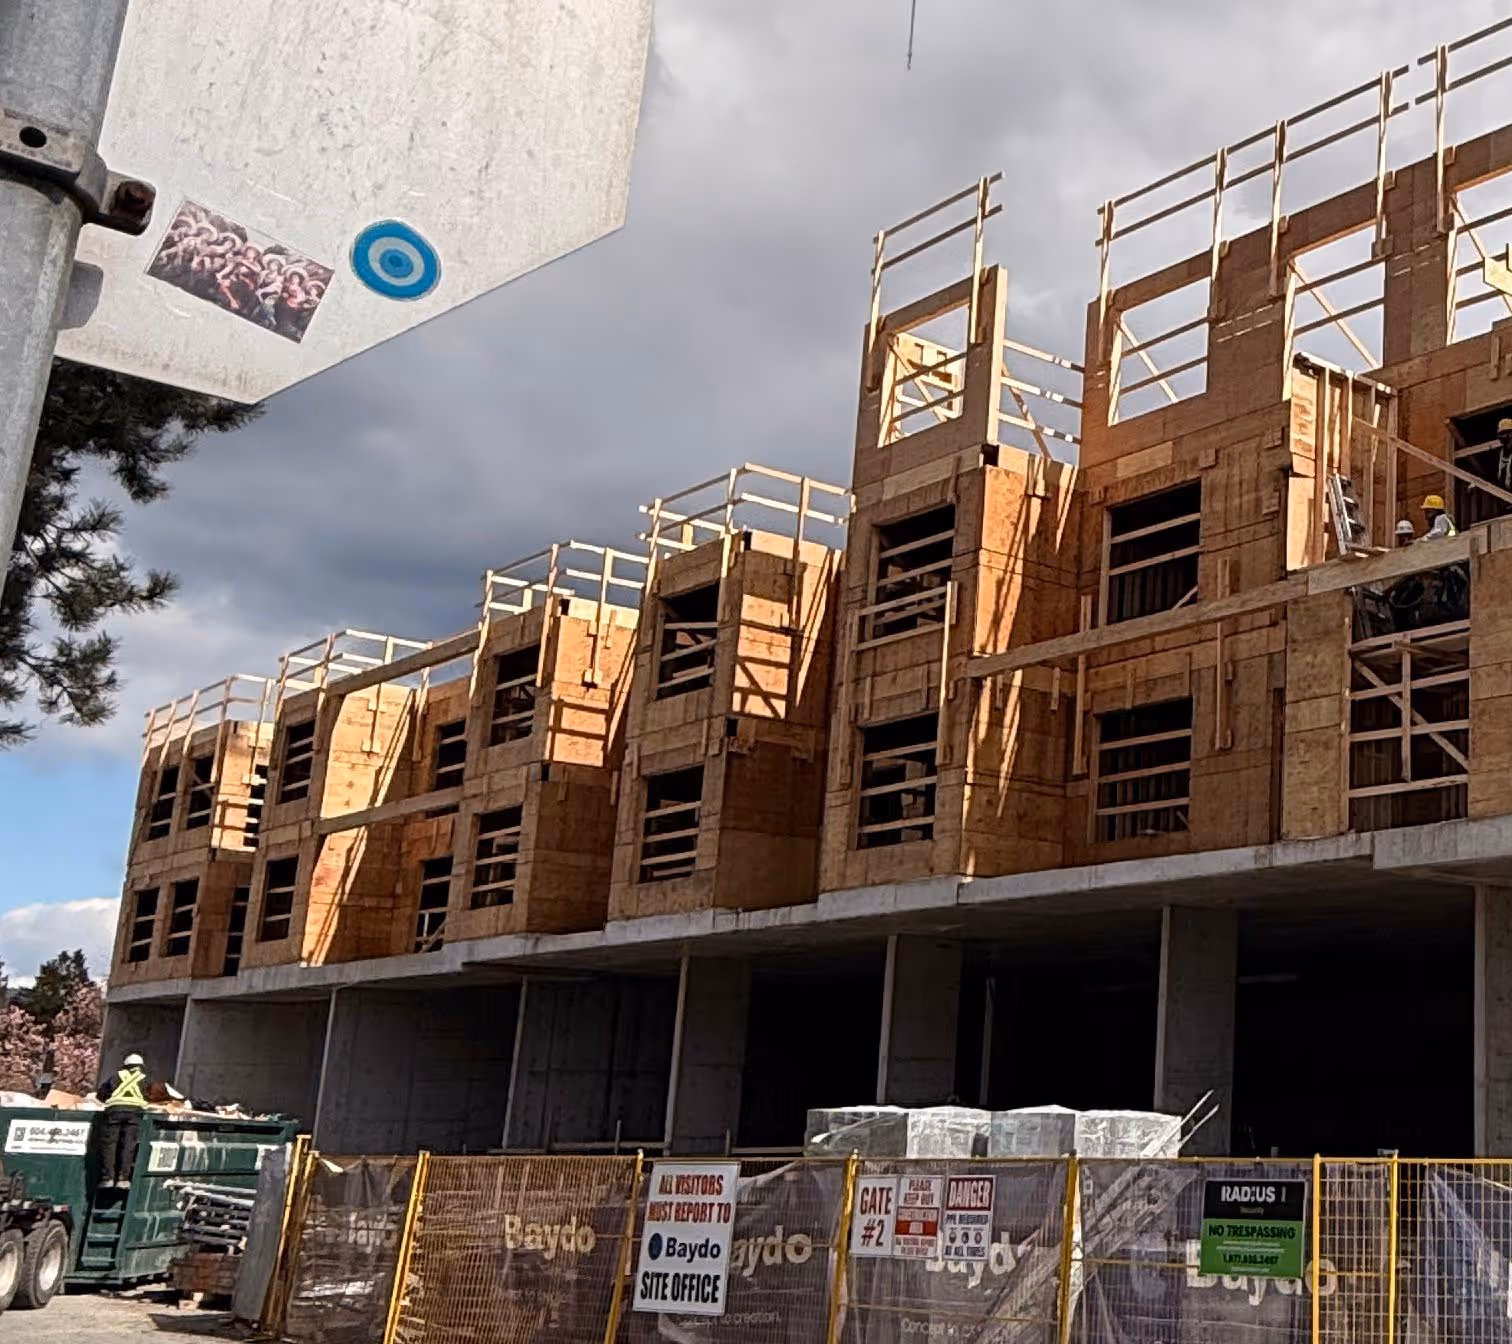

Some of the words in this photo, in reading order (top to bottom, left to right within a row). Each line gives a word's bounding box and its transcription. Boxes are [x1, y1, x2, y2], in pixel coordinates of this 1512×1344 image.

[658, 1175, 673, 1196] ALL
[675, 1175, 724, 1197] VISITORS
[949, 1180, 991, 1208] DANGER
[1221, 1186, 1276, 1204] RADIUS
[647, 1201, 673, 1223] MUST
[674, 1202, 713, 1224] REPORT
[716, 1202, 732, 1224] TO
[860, 1186, 894, 1216] GATE
[503, 1214, 598, 1260] Baydo
[861, 1218, 885, 1248] #2
[1208, 1224, 1226, 1237] NO
[1226, 1224, 1297, 1240] TRESPASSING
[666, 1237, 722, 1264] Baydo
[731, 1224, 813, 1277] aydo
[640, 1270, 670, 1301] SITE
[671, 1272, 721, 1304] OFFICE
